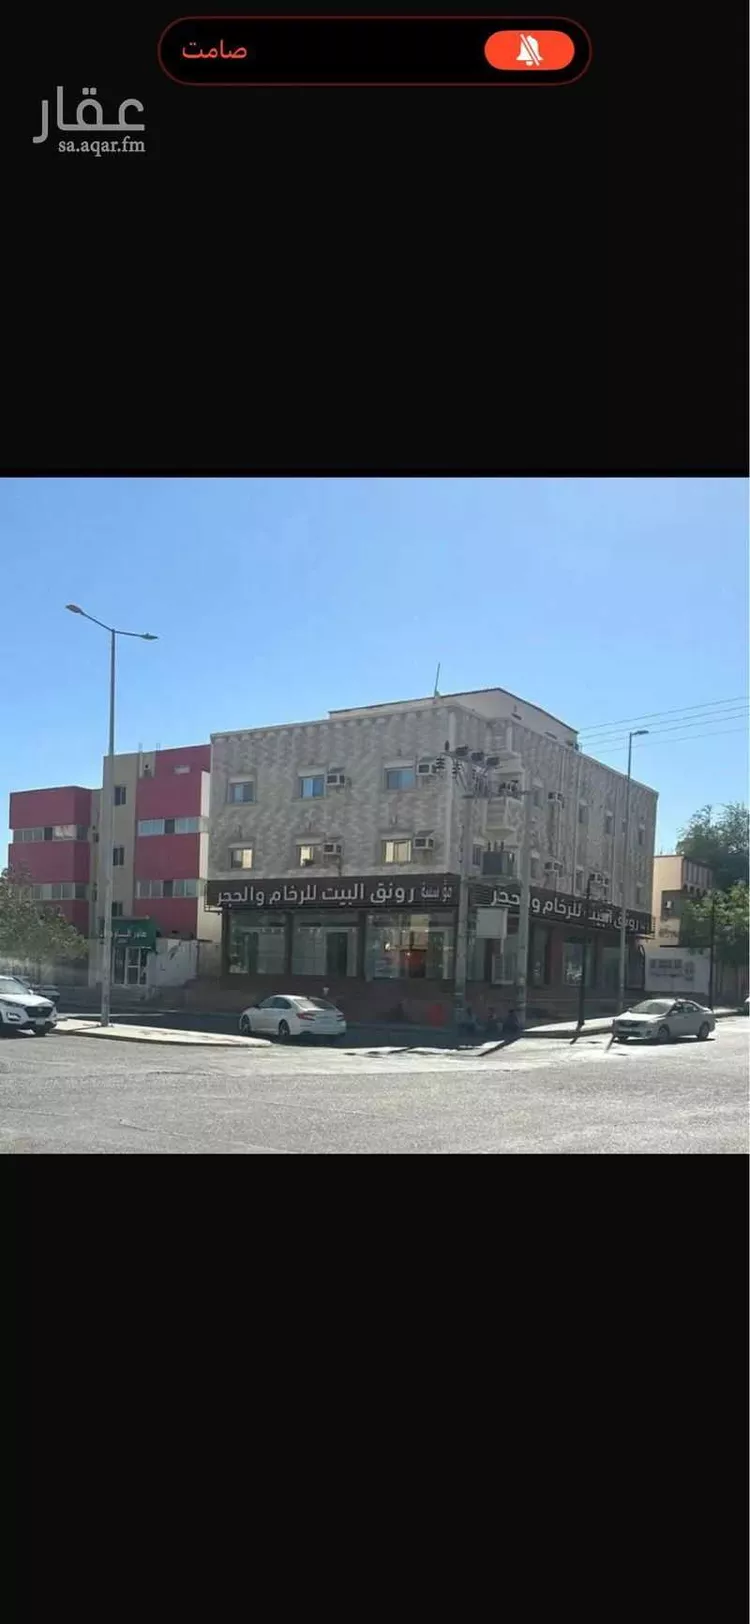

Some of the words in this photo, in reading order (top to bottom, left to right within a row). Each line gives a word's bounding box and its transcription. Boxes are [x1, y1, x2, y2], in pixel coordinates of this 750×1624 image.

[217, 885, 264, 907] والحجر
[268, 884, 317, 906] للرخام
[321, 883, 364, 906] البيت
[370, 881, 415, 904] رونق
[542, 897, 582, 919] للرخام
